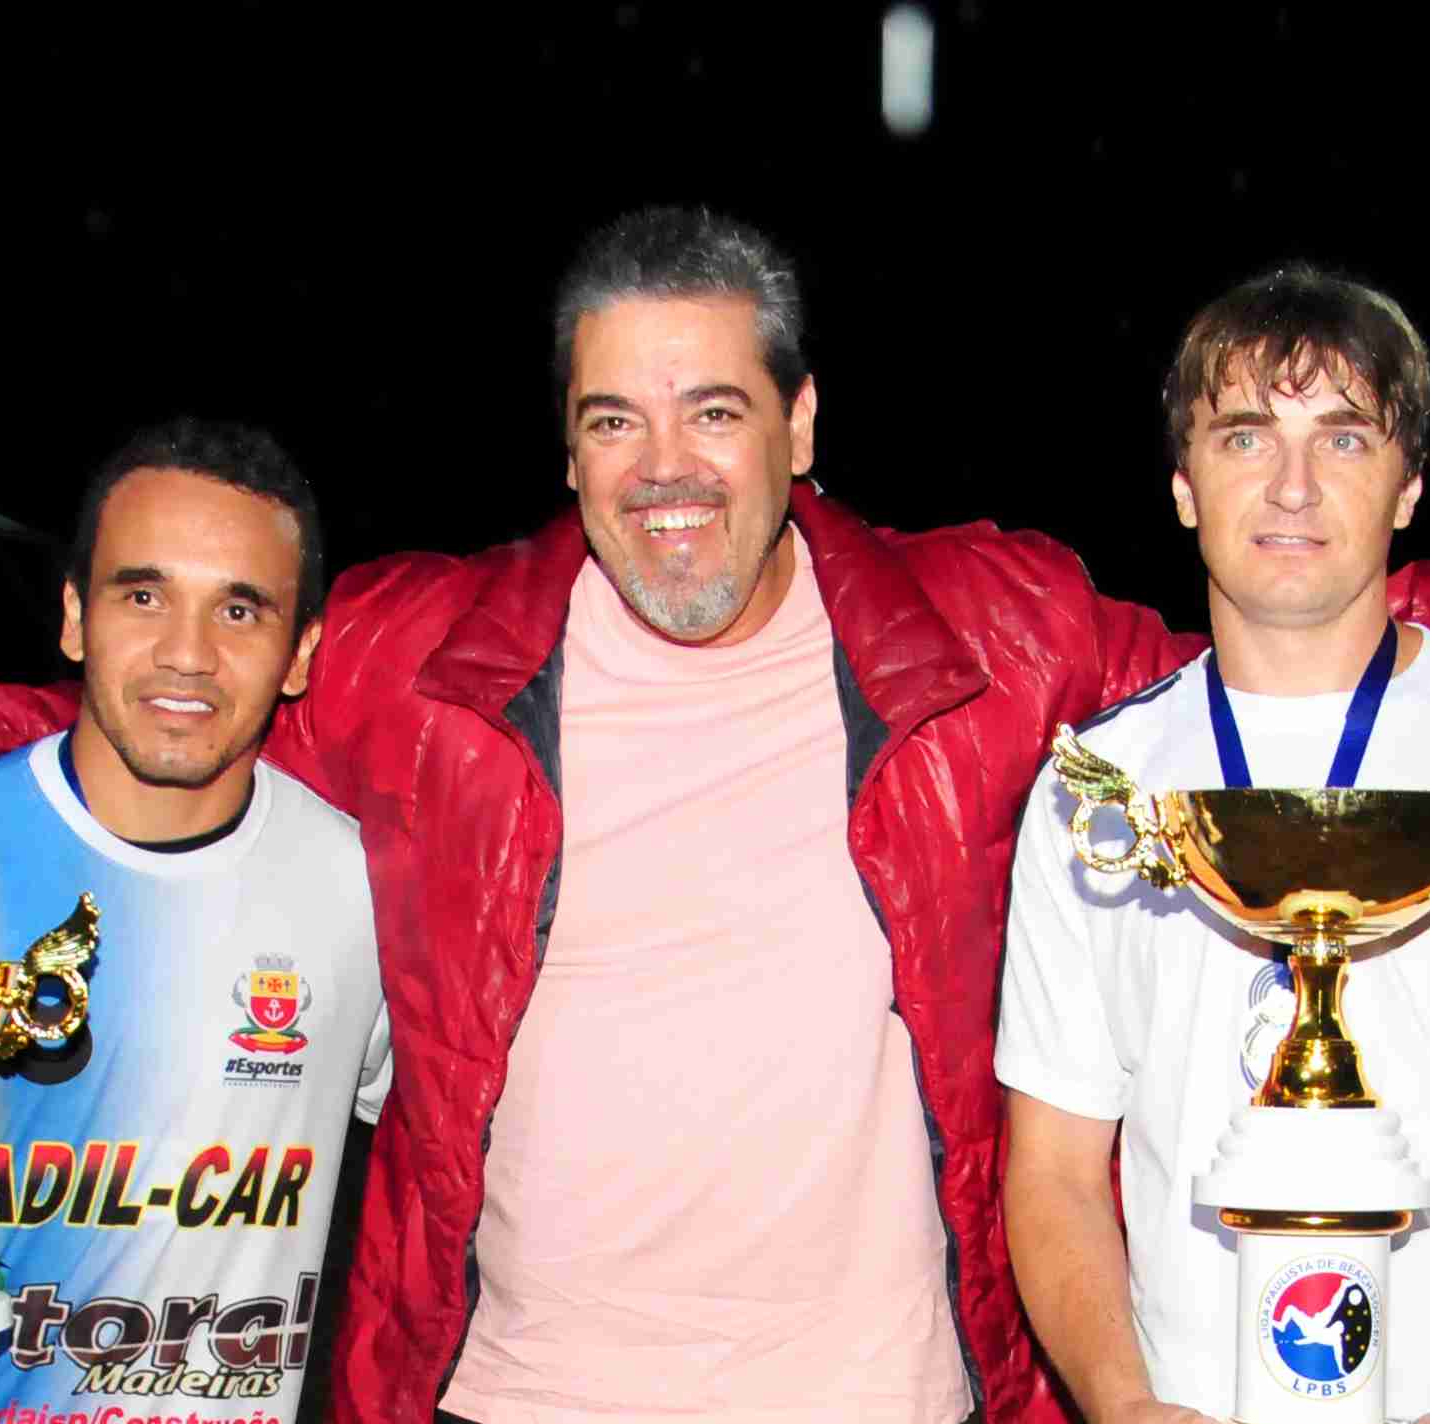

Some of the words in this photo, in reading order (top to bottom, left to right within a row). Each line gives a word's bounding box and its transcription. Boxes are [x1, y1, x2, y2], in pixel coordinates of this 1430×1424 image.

[225, 1058, 303, 1079] #Esportes
[1265, 1261, 1314, 1304] PAULISTA
[10, 1272, 319, 1371] toral
[72, 1363, 282, 1398] Madeiras
